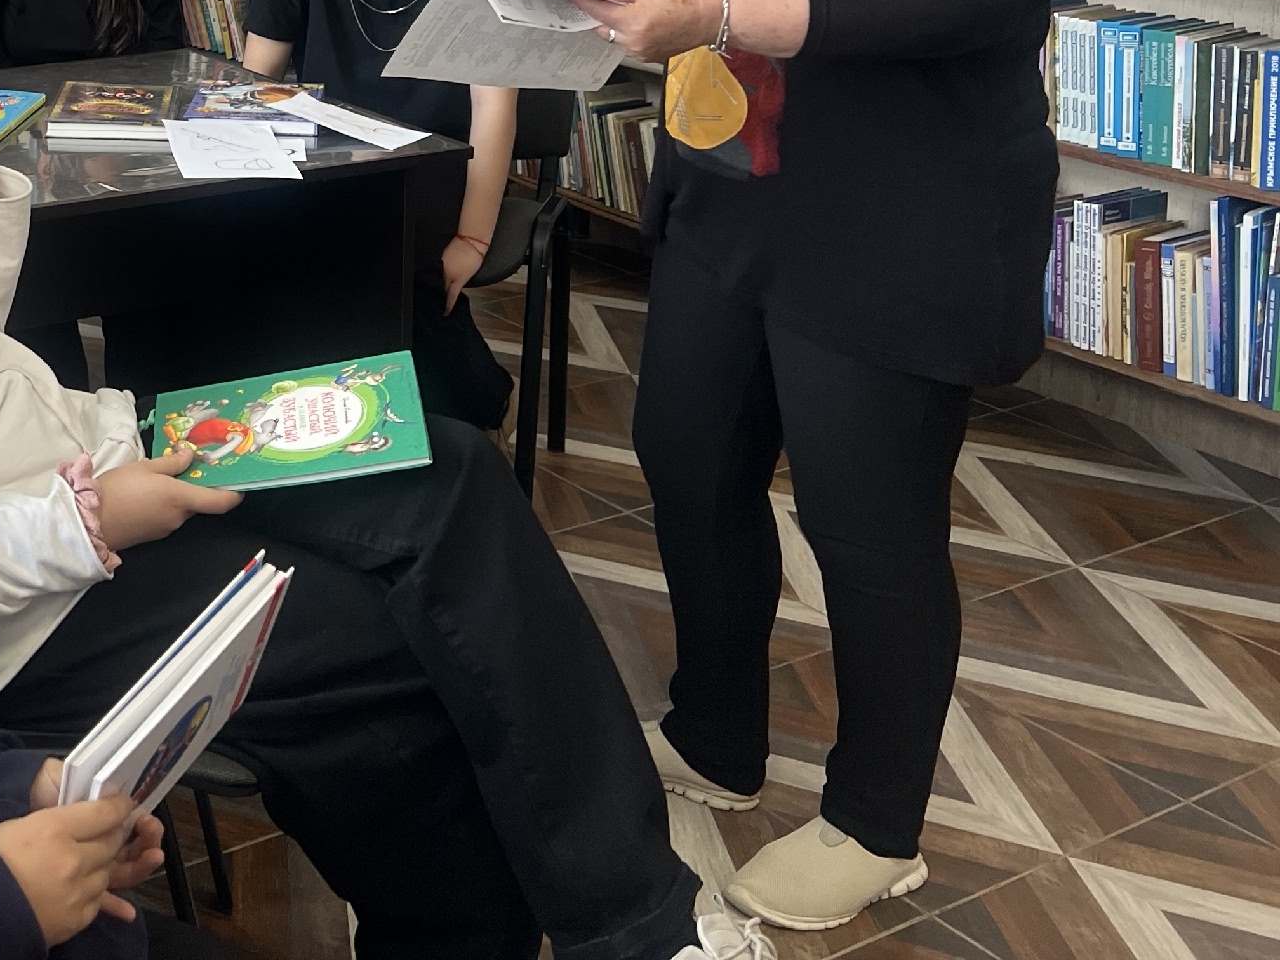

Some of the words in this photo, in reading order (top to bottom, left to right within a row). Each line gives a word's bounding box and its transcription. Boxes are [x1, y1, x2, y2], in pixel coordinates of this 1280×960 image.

[1149, 41, 1158, 85] Коктебеля
[1165, 43, 1173, 87] Коктебеля
[1271, 55, 1279, 72] 2018
[1268, 75, 1278, 139] ПРИКЛЮЧЕНИЕ
[1266, 141, 1276, 187] КРЫМСКОЕ
[280, 397, 300, 443] ЗУБАСТЫЙ
